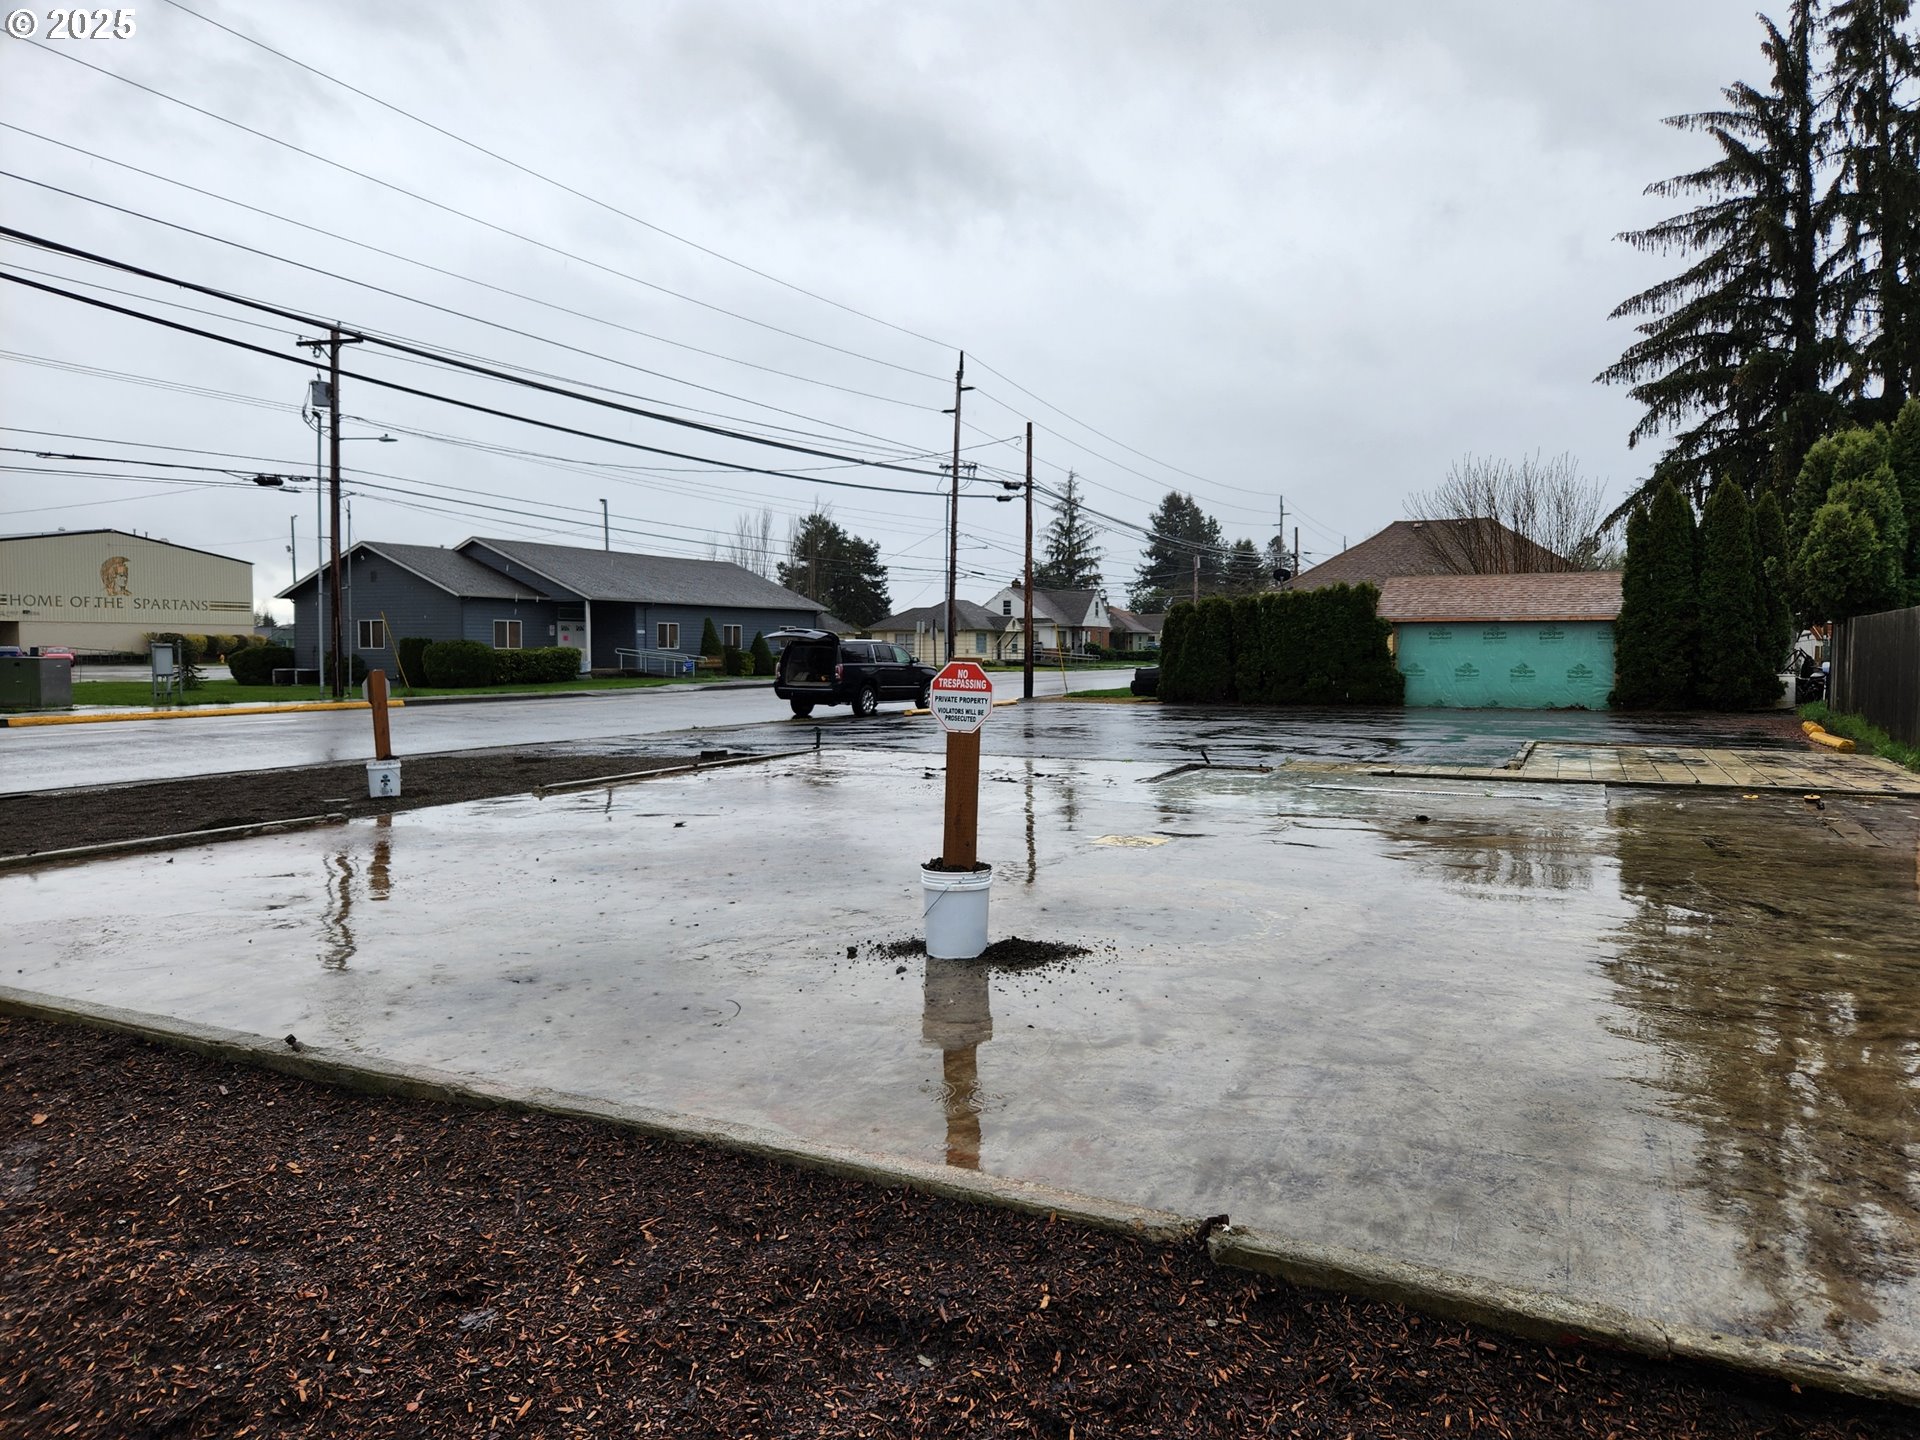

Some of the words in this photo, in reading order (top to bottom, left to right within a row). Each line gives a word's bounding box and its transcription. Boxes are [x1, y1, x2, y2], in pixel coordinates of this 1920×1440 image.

[10, 594, 63, 607] HOME
[70, 596, 90, 608] OF
[94, 597, 124, 609] THE
[133, 597, 209, 611] SPARTANS
[957, 669, 969, 678] NO
[938, 678, 987, 689] TRESPASSING
[959, 697, 989, 705] PROPERTY
